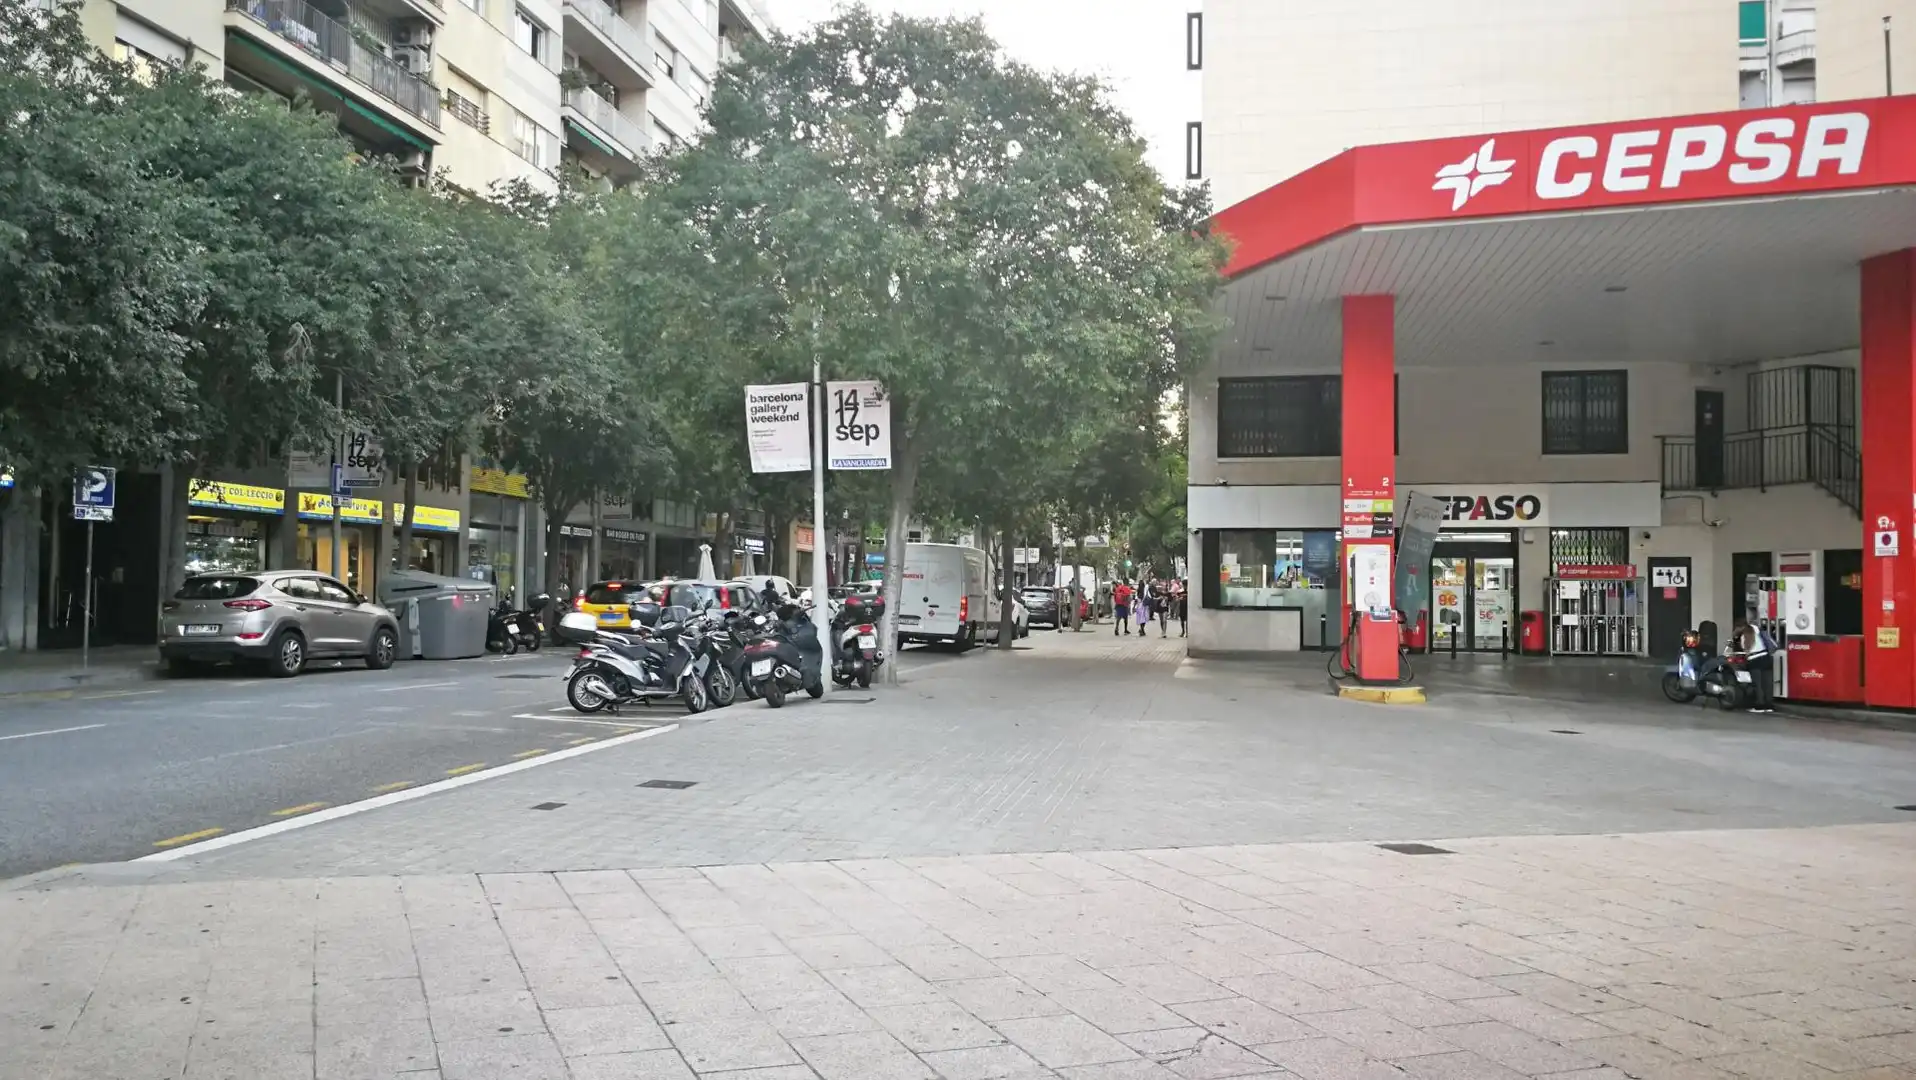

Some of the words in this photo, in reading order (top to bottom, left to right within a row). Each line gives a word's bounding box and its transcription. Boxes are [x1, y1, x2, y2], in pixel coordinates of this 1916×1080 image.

[1534, 112, 1870, 200] CEPSA
[749, 392, 804, 404] barcelona
[834, 389, 860, 407] 14
[750, 403, 788, 416] gallery
[835, 405, 859, 427] 17
[750, 411, 800, 424] weekend
[836, 424, 880, 446] sep
[347, 456, 378, 473] sep
[1347, 477, 1354, 487] 1
[1382, 477, 1389, 487] 2
[1479, 610, 1494, 620] 5€
